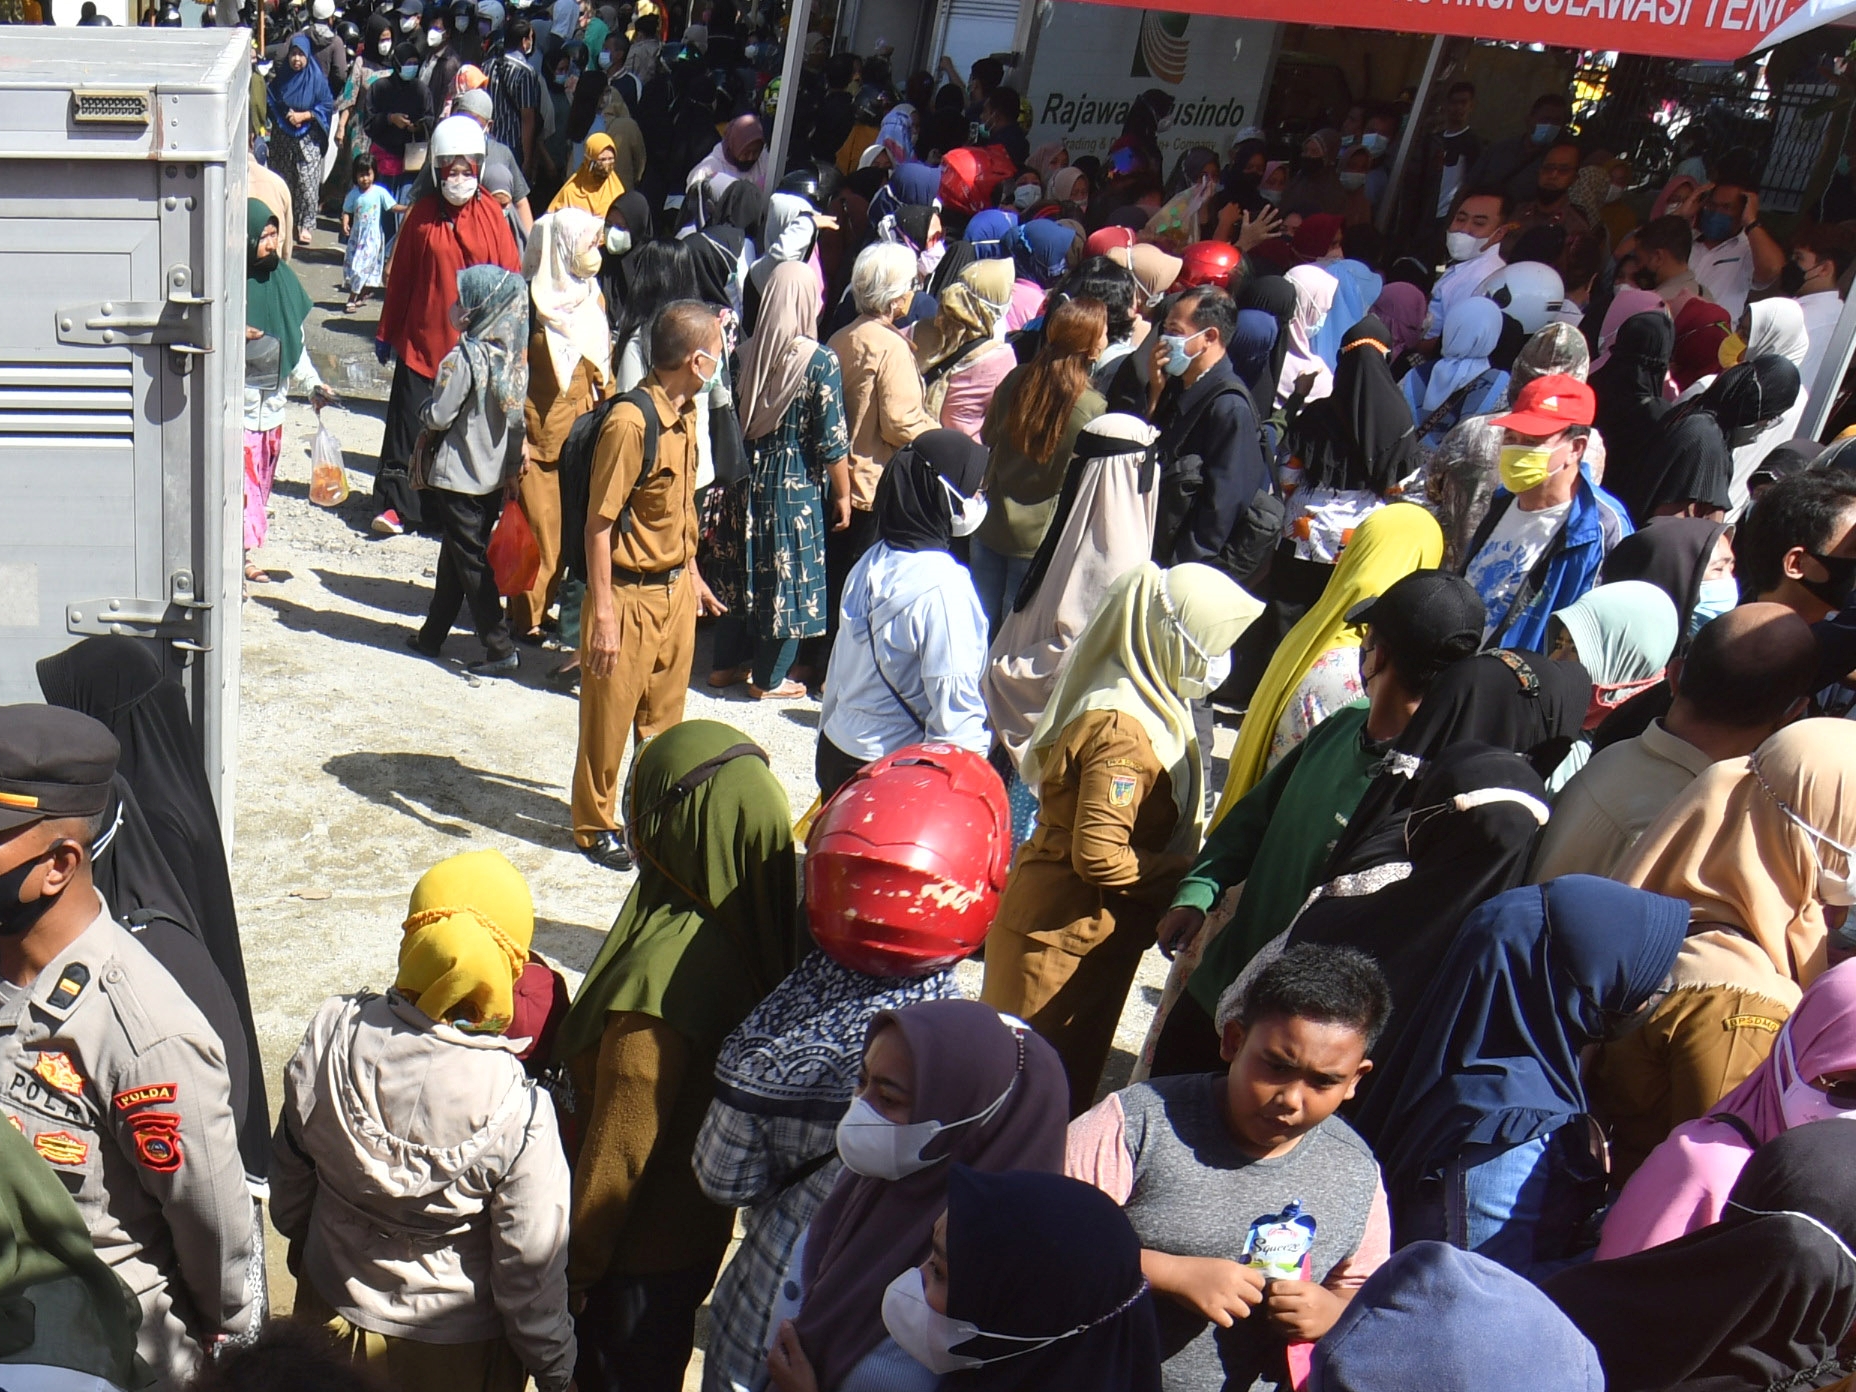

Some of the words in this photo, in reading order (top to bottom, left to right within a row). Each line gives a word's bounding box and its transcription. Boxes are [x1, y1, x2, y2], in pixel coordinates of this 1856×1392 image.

[1041, 93, 1141, 132] Rajawa
[1168, 96, 1245, 127] usindo
[121, 1087, 171, 1107] POLDA
